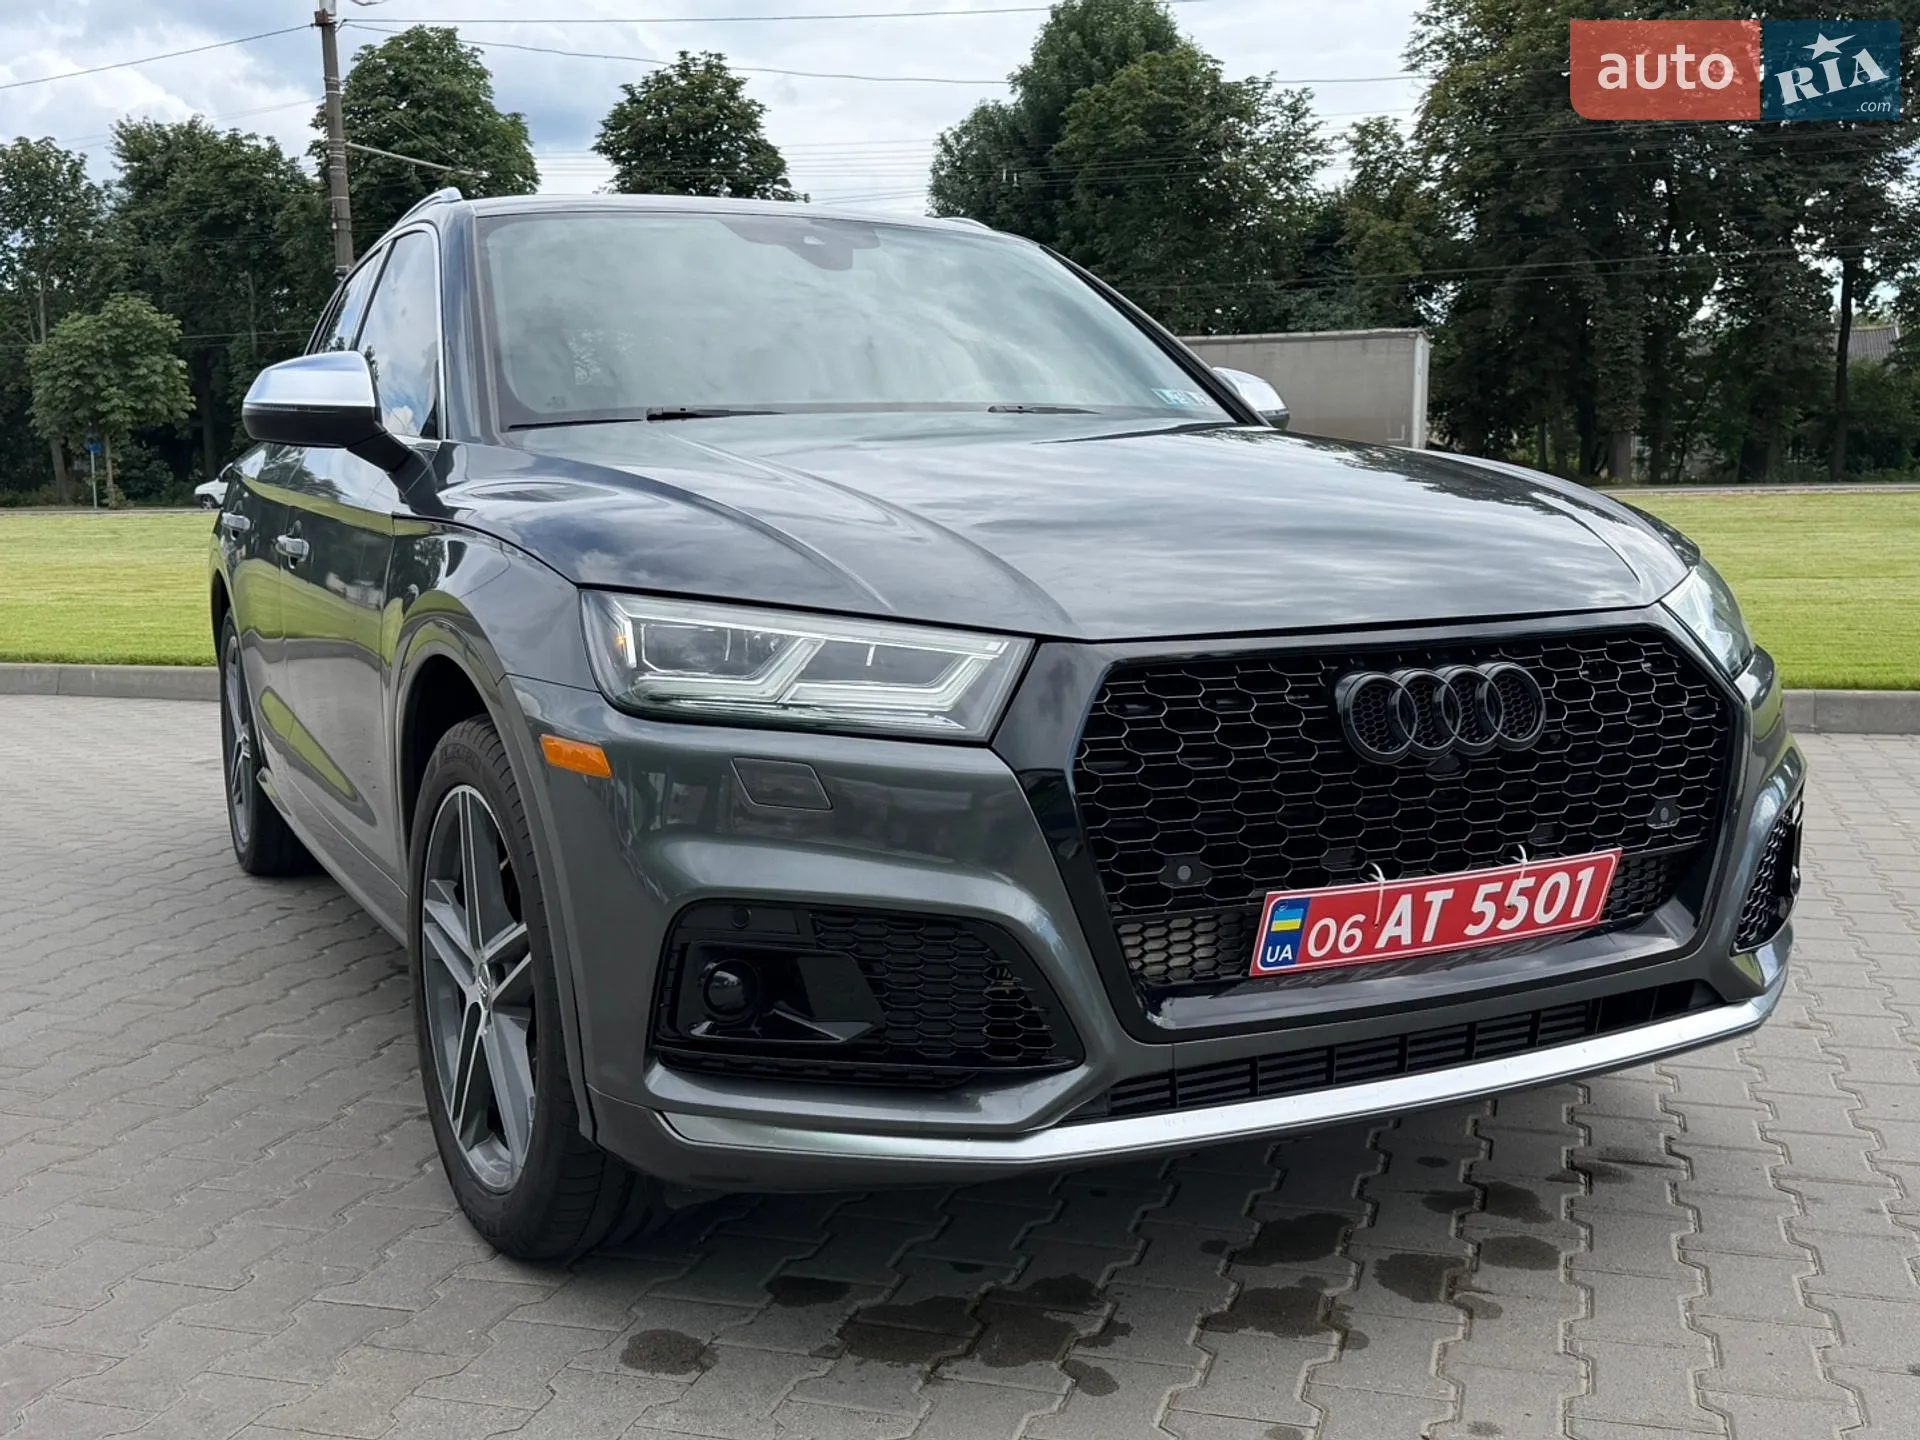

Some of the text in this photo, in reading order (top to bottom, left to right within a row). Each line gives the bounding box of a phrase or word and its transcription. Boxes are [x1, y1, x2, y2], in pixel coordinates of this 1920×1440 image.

[1307, 866, 1596, 957] 06 AT 5501
[1266, 943, 1293, 963] UA
